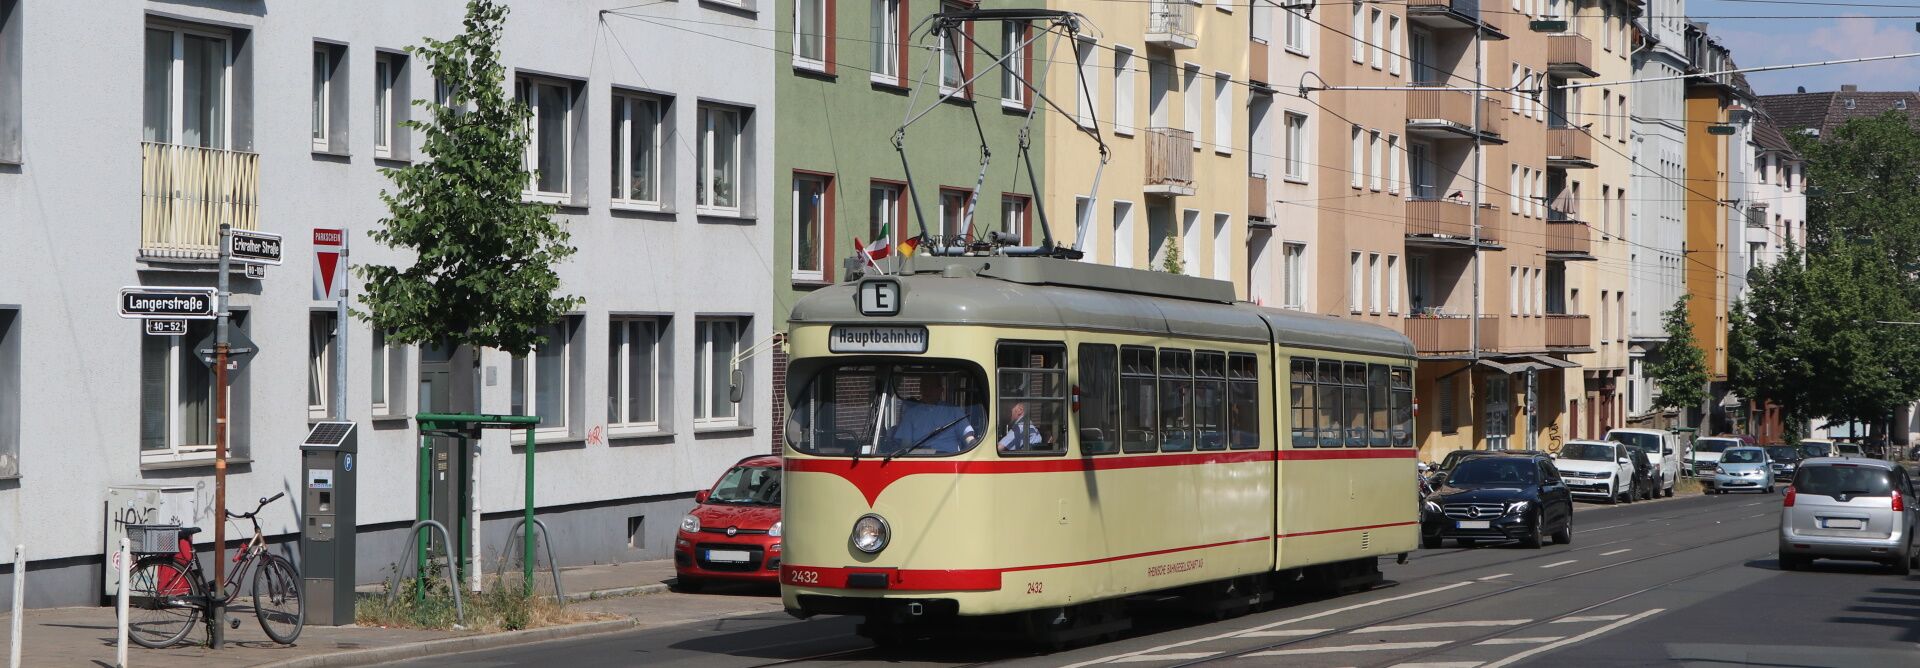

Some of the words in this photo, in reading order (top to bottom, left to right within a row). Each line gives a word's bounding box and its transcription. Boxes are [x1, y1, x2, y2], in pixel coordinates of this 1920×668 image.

[234, 237, 261, 253] Erkrather
[261, 240, 279, 256] Straße
[129, 295, 203, 312] Langerstraße
[875, 283, 888, 309] E
[839, 328, 924, 347] Hauptbahnhof
[791, 570, 819, 584] 2432
[1027, 581, 1043, 594] 2432
